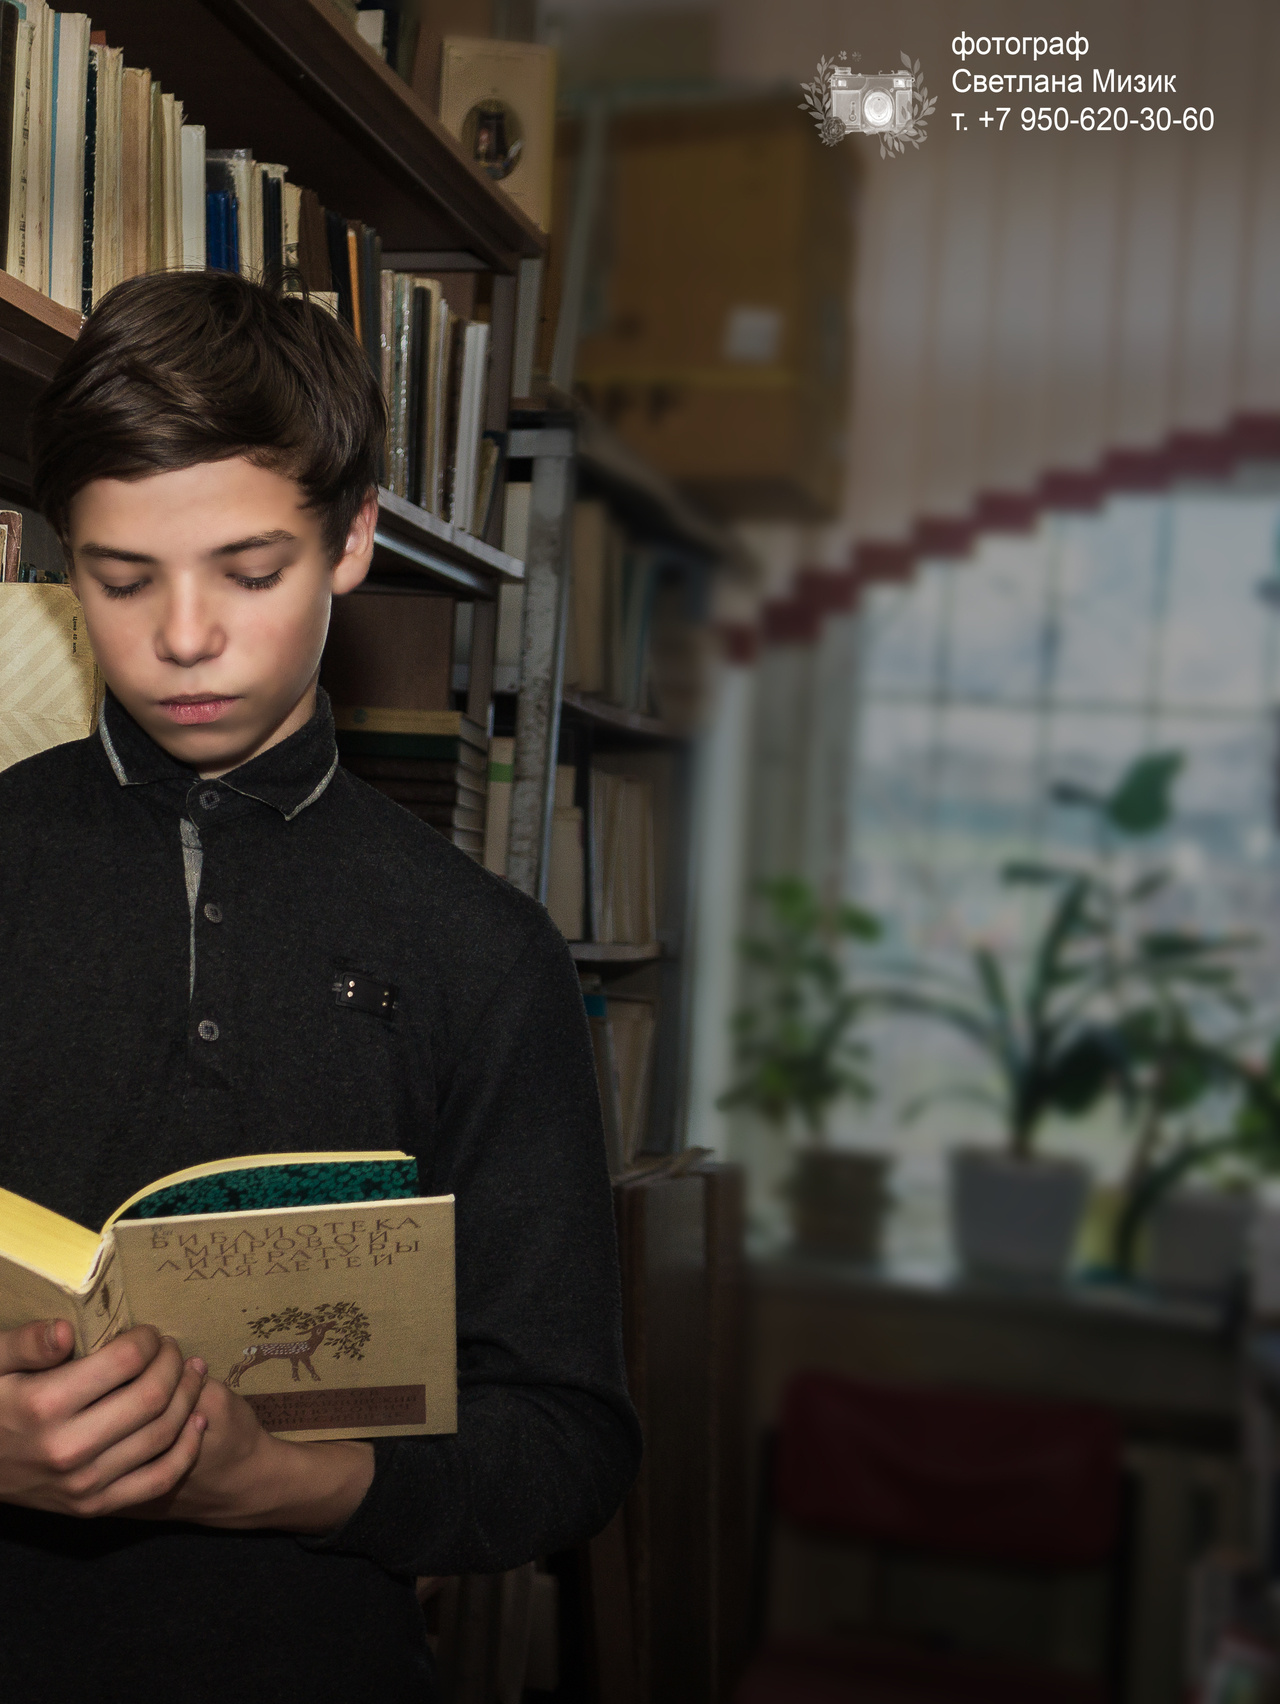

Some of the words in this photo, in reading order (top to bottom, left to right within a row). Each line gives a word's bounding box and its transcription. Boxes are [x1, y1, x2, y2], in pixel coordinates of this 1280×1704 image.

[151, 1217, 421, 1249] БИБЛИОТЕКА
[184, 1230, 389, 1257] МИРОВОЙ
[156, 1241, 420, 1272] ЛИТЕРАТУРЫ
[183, 1264, 252, 1282] ДЛЯ
[265, 1253, 393, 1275] ДЕТЕЙ
